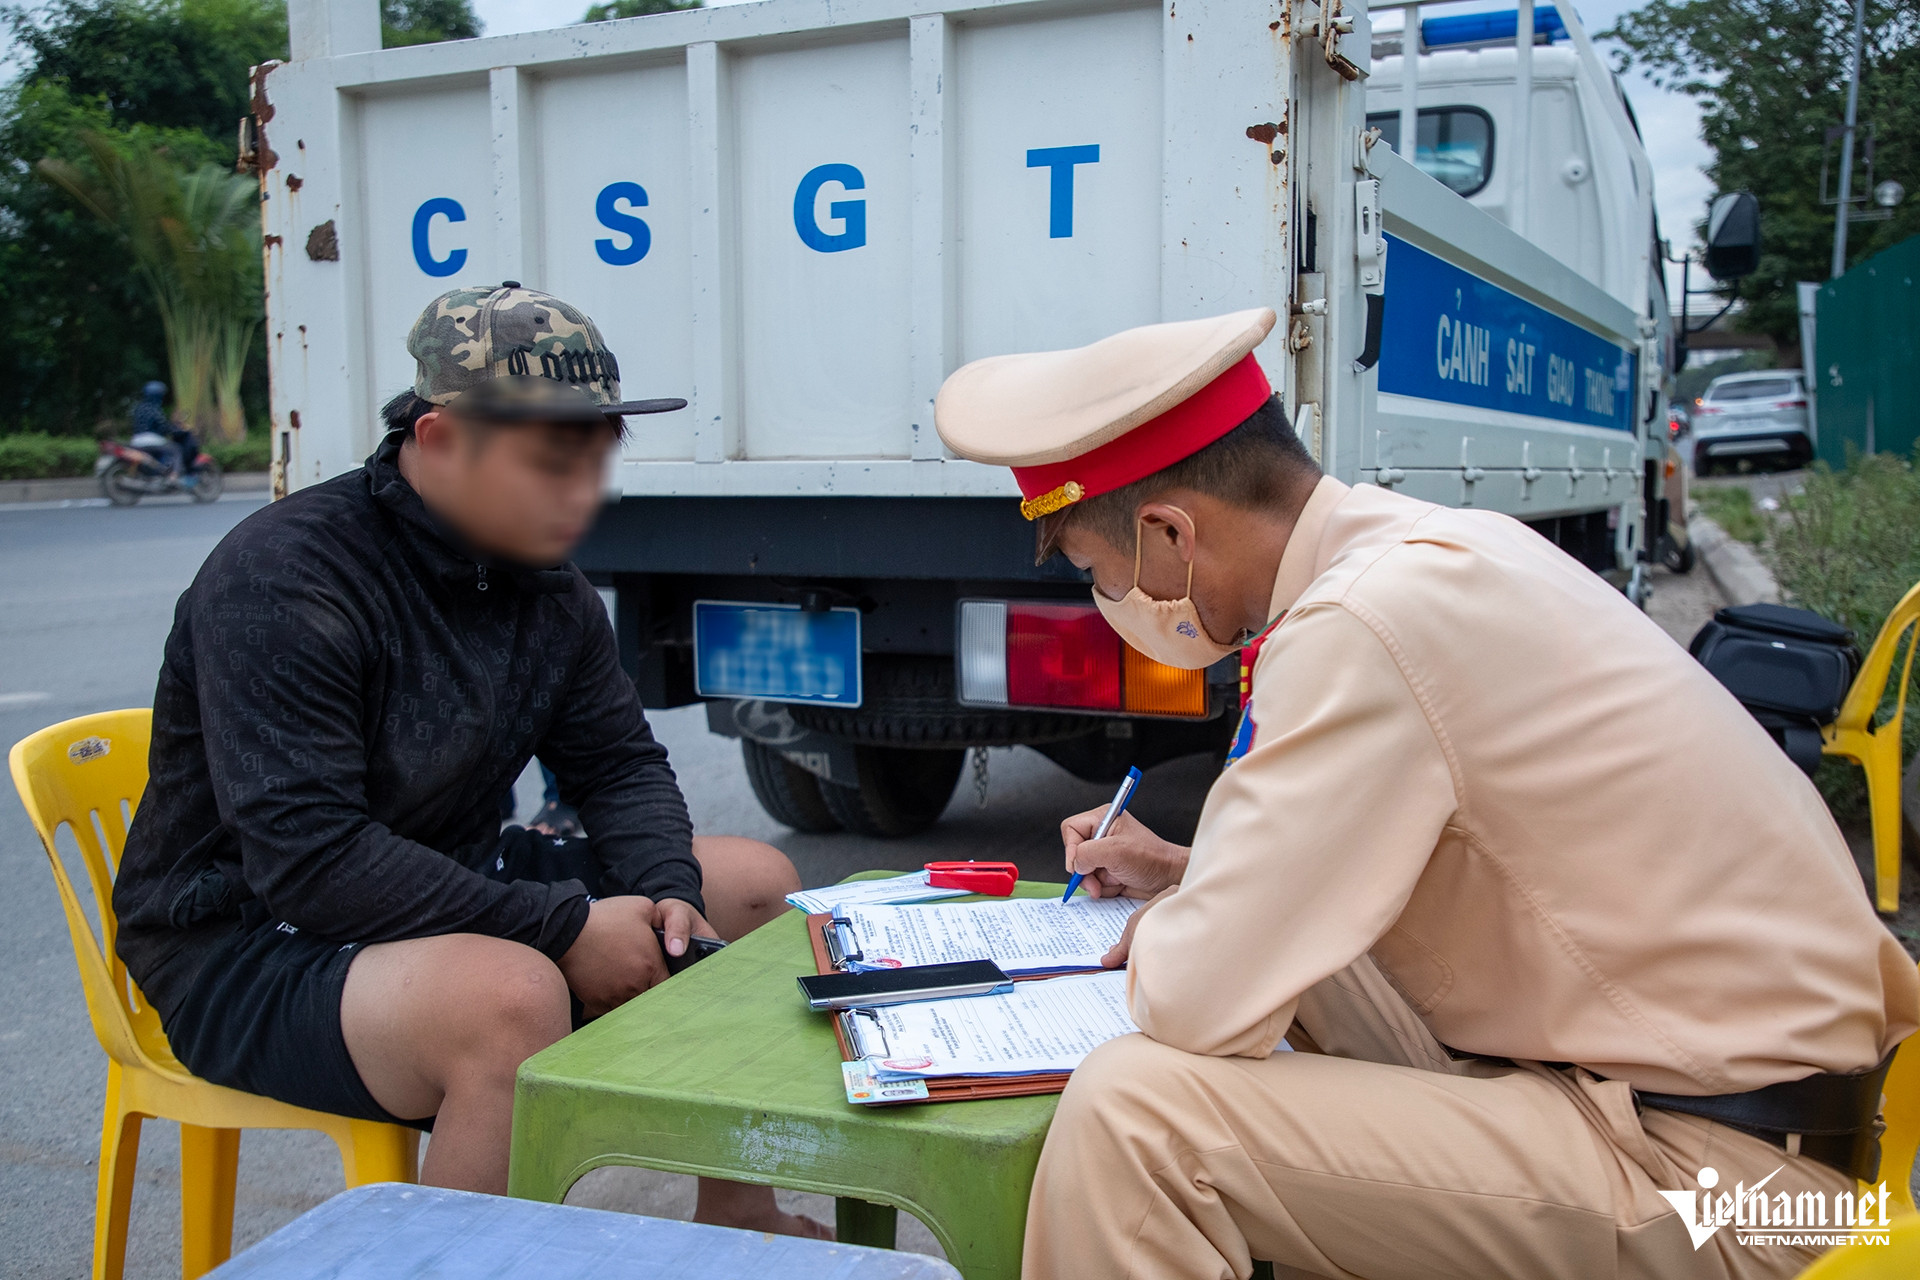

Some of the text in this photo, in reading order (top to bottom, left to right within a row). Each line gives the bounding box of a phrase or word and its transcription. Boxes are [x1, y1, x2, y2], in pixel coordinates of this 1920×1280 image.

[412, 144, 1100, 277] C S G T
[1437, 288, 1490, 387] CẢNH
[1506, 323, 1536, 396] SÁT
[1547, 353, 1575, 407] GIAO
